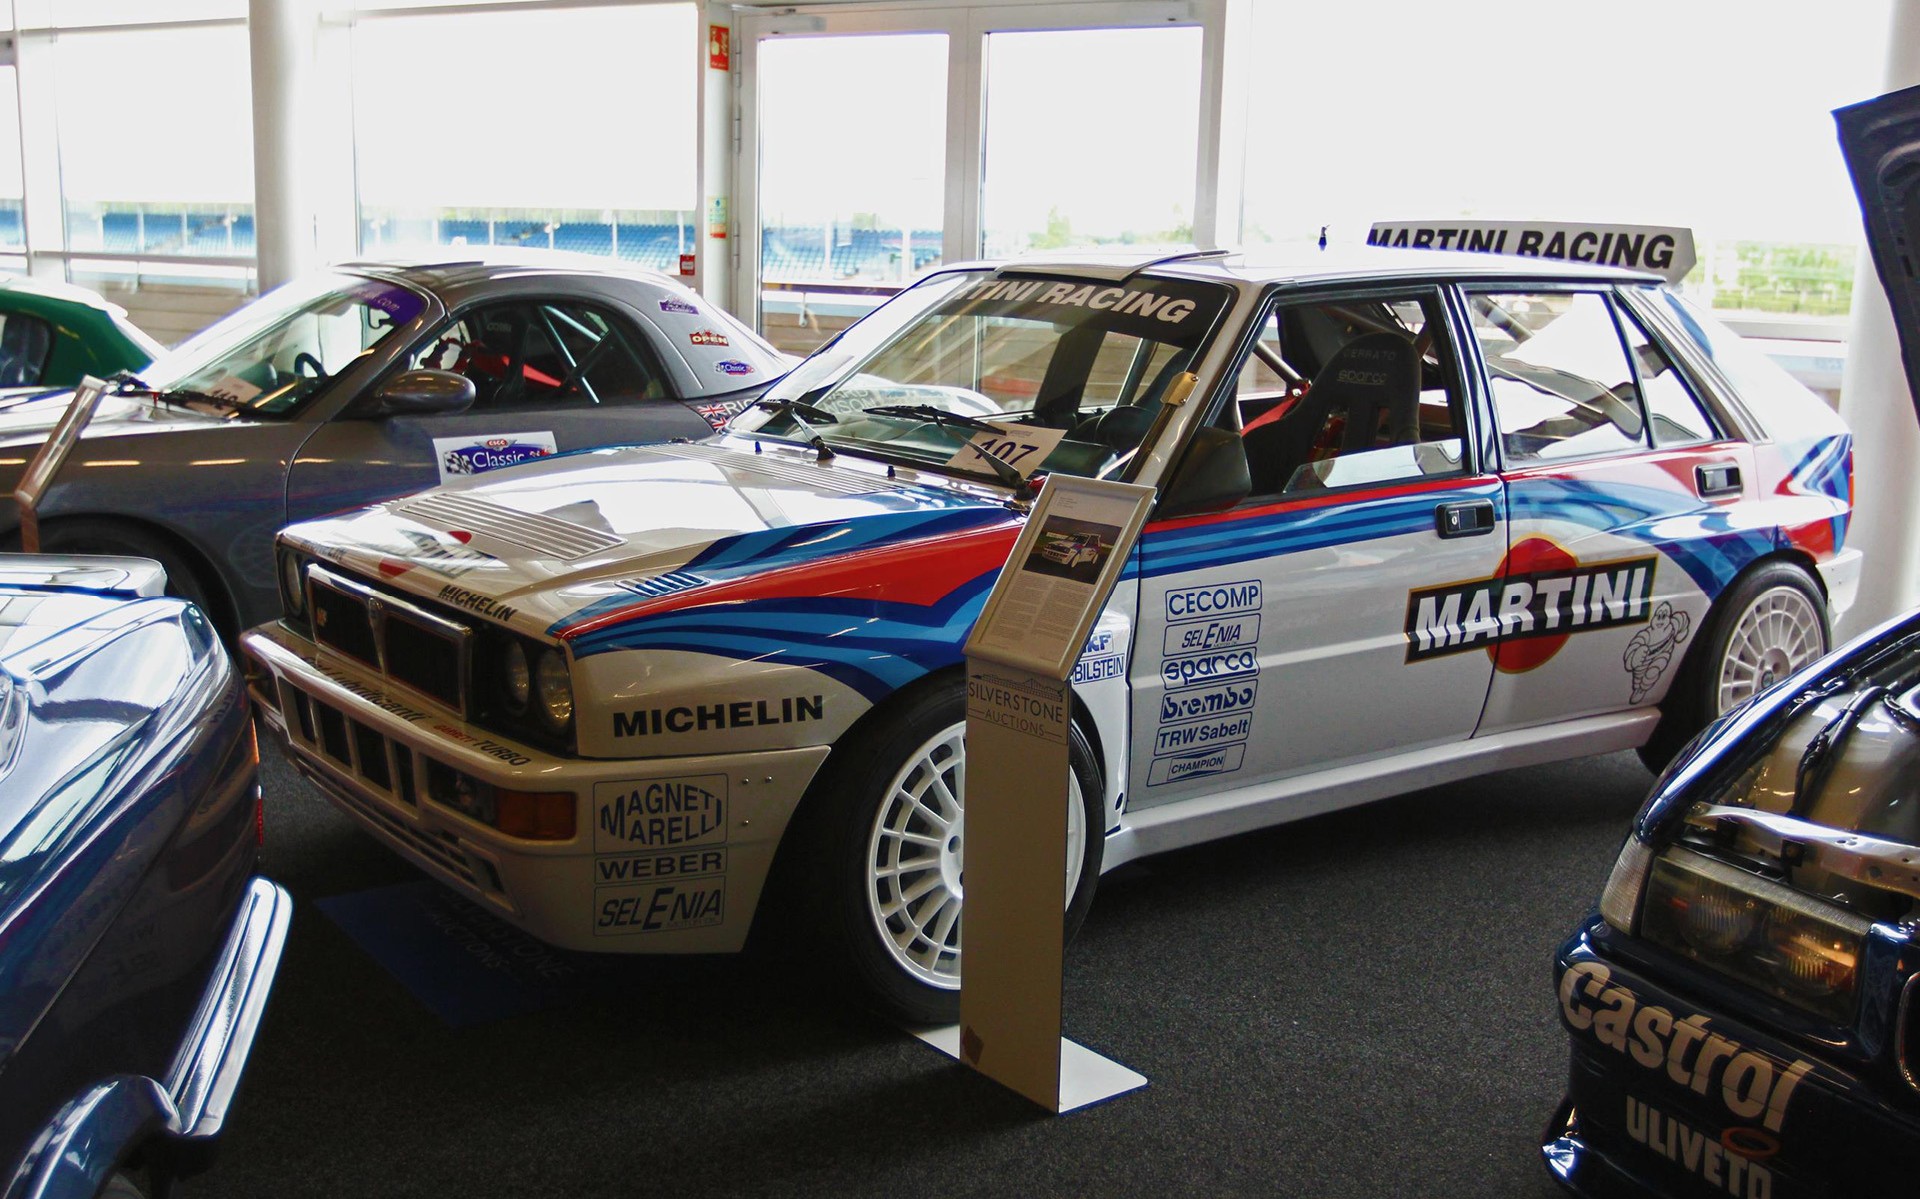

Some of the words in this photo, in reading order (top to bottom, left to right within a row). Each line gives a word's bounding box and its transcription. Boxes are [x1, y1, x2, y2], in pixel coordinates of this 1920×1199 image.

[1367, 229, 1508, 255] MARTINI
[1517, 230, 1676, 270] RACING
[1036, 283, 1196, 324] RACING
[692, 335, 728, 345] OPEN
[472, 450, 525, 468] Classic
[438, 584, 519, 623] MICHELIN
[1168, 585, 1259, 616] CECOMP
[1415, 567, 1648, 652] MARTINI
[1083, 634, 1112, 653] KF
[1182, 623, 1242, 649] SELENIA
[1074, 656, 1124, 682] BILSTEIN
[1164, 651, 1254, 685] sparco
[613, 695, 823, 738] MICHELIN
[968, 682, 1063, 724] SILVERSTONE
[1162, 687, 1253, 720] brembo
[985, 709, 1045, 737] AUCTIONS
[1160, 727, 1199, 748] TRW
[1199, 719, 1248, 741] Sabelt
[472, 740, 532, 766] TURBO
[1171, 756, 1224, 774] CHAMPION
[598, 852, 722, 880] WEBER
[598, 886, 721, 930] SELENIA
[1559, 961, 1815, 1133] Castrol
[1626, 1095, 1772, 1199] ULIVETO
